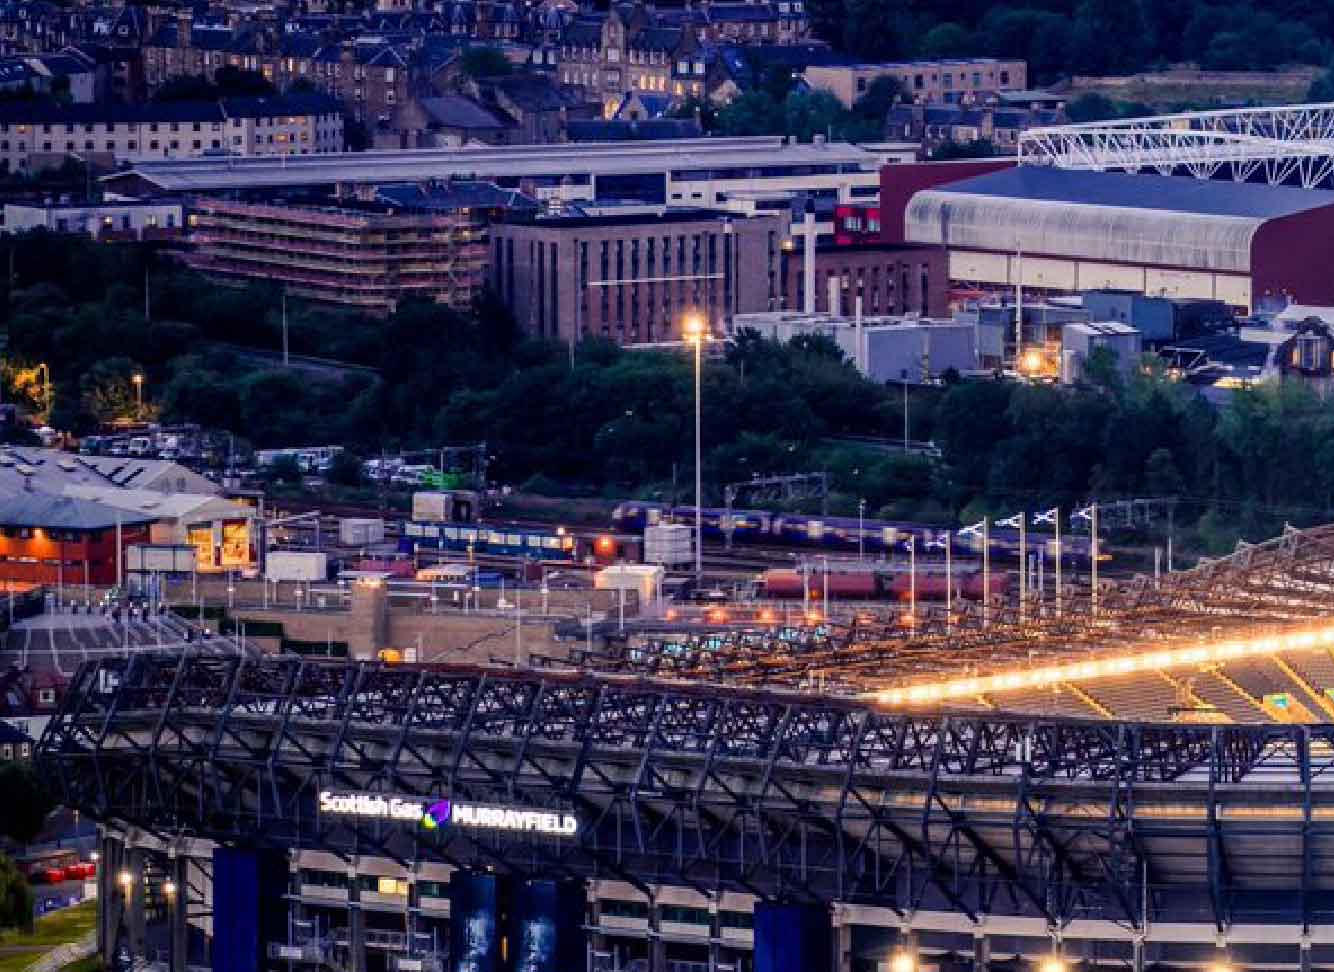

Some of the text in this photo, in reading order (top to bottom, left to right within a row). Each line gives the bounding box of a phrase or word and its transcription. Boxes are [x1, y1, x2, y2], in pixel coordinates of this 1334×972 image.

[320, 791, 577, 833] Scottish Gas MURRAYFIELD
